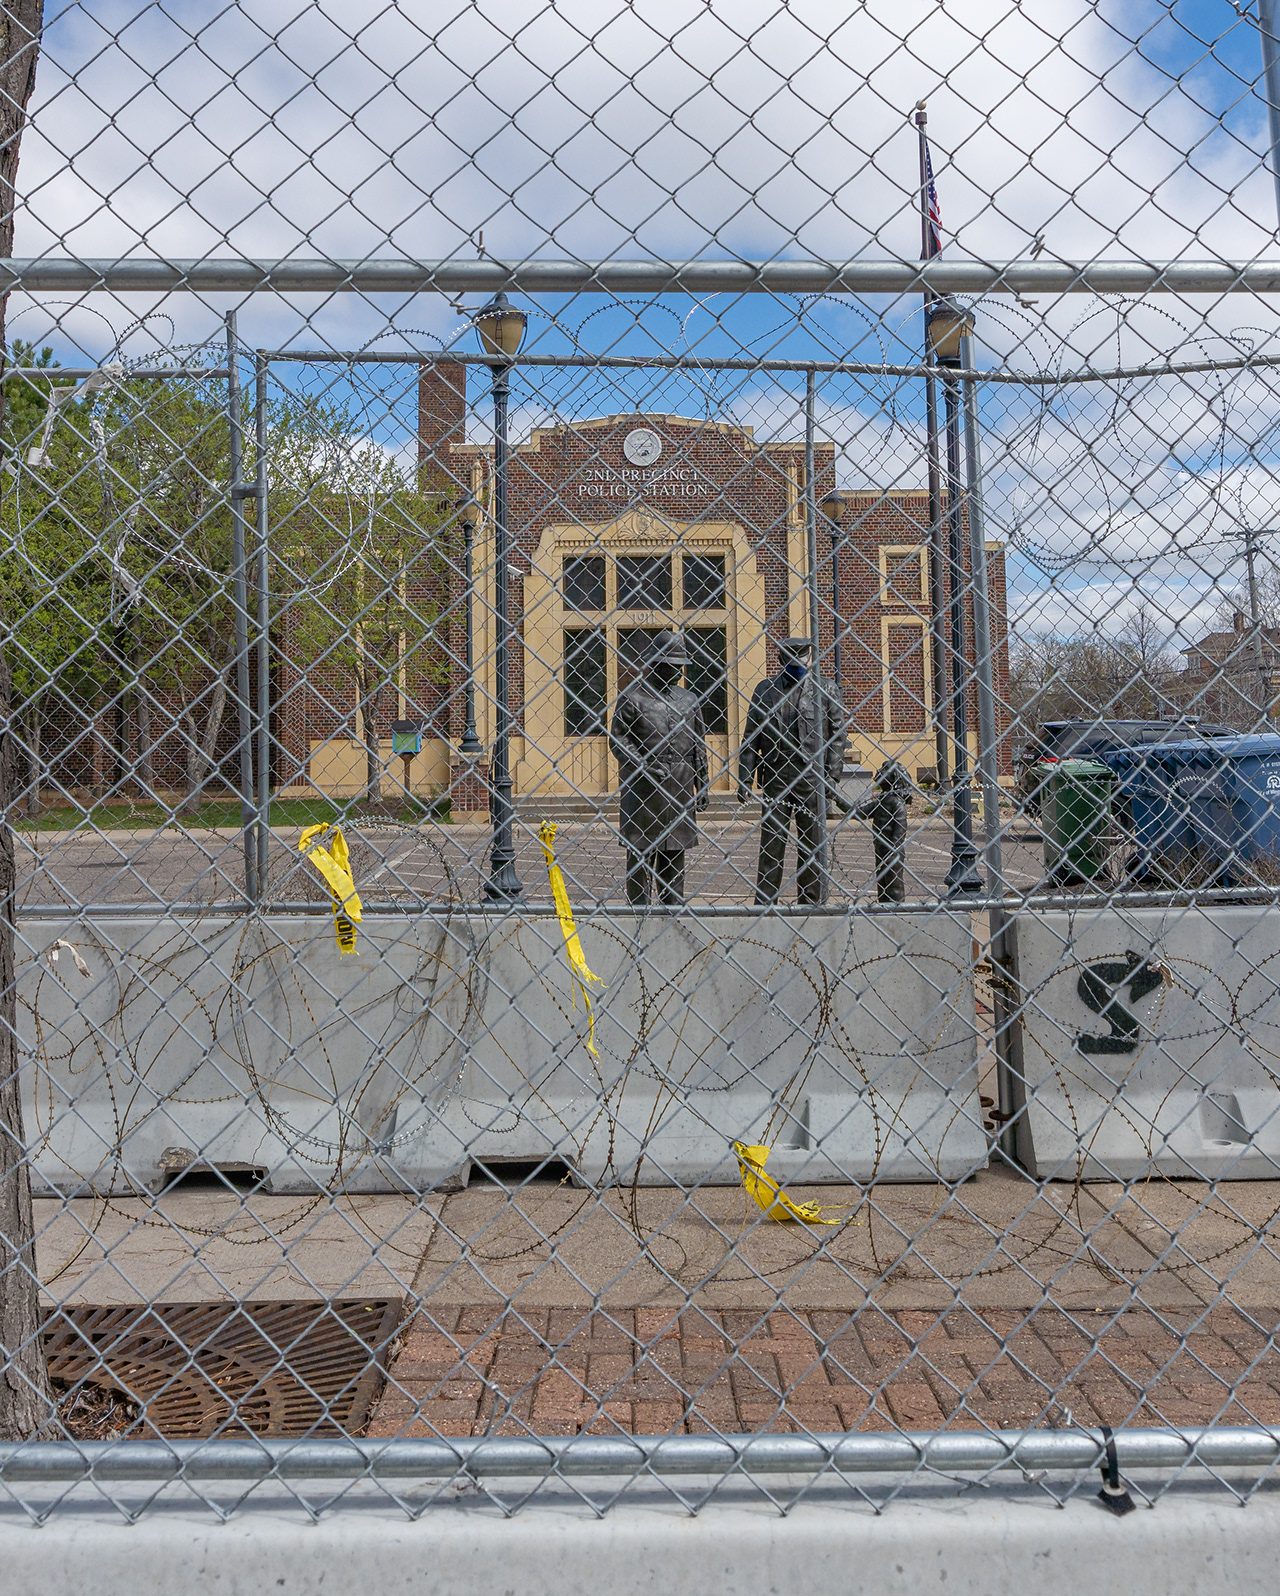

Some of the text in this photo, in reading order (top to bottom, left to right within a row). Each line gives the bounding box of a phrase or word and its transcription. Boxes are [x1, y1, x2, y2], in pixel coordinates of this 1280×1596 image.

[585, 469, 698, 481] 2ND PRECINCT
[579, 484, 707, 496] POLICE STATION
[634, 612, 656, 624] 1911
